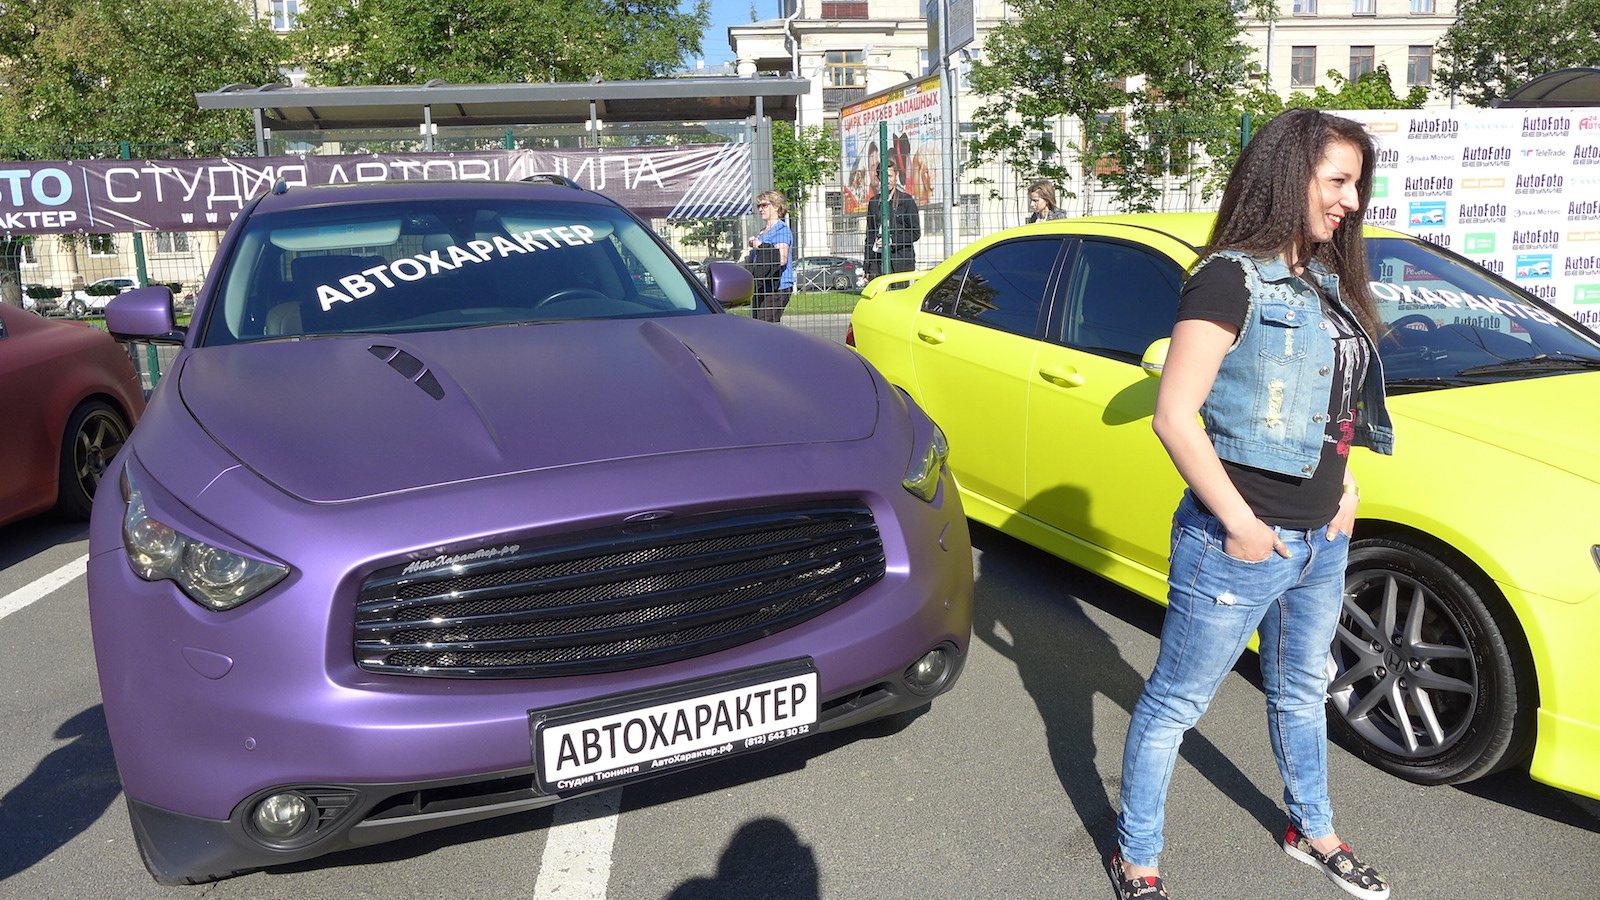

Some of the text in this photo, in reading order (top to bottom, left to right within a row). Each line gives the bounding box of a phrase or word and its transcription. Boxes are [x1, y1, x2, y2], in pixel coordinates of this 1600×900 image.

[844, 114, 862, 132] ЦИРК
[863, 105, 893, 126] БРАТЬЕВ
[894, 91, 939, 116] ЗАПАШНЫХ
[923, 113, 933, 126] 29
[0, 168, 73, 206] ТО
[316, 224, 594, 312] АВТОХАРАКТЕР
[556, 682, 807, 771] АВТОХАРАКТЕР
[557, 724, 810, 790] Студия Тюнинга АвтоХарактер.рф (812) 642 30 32
